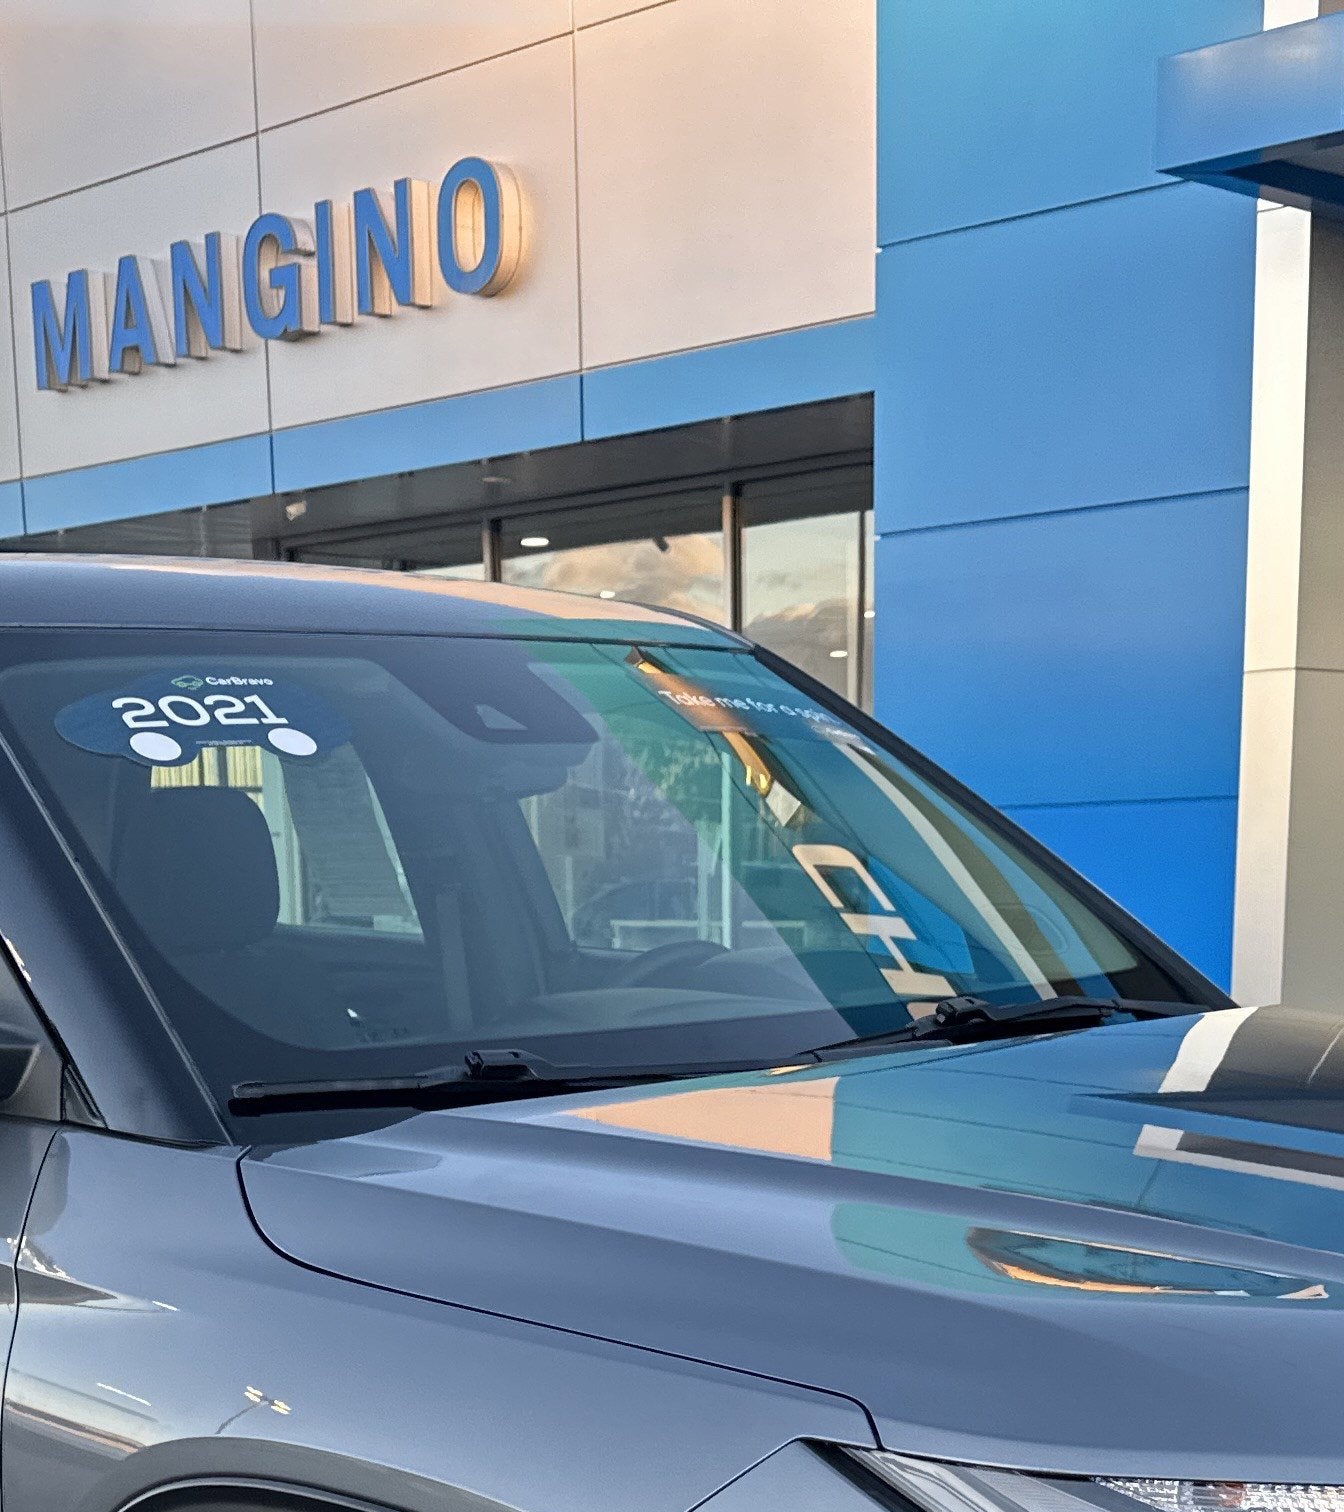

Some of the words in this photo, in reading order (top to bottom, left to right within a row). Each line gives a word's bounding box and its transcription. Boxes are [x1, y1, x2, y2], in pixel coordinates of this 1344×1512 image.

[31, 156, 514, 391] MANGINO
[205, 675, 273, 687] CarBravo
[112, 694, 288, 729] 2021
[658, 690, 716, 706] Take
[714, 697, 750, 710] me
